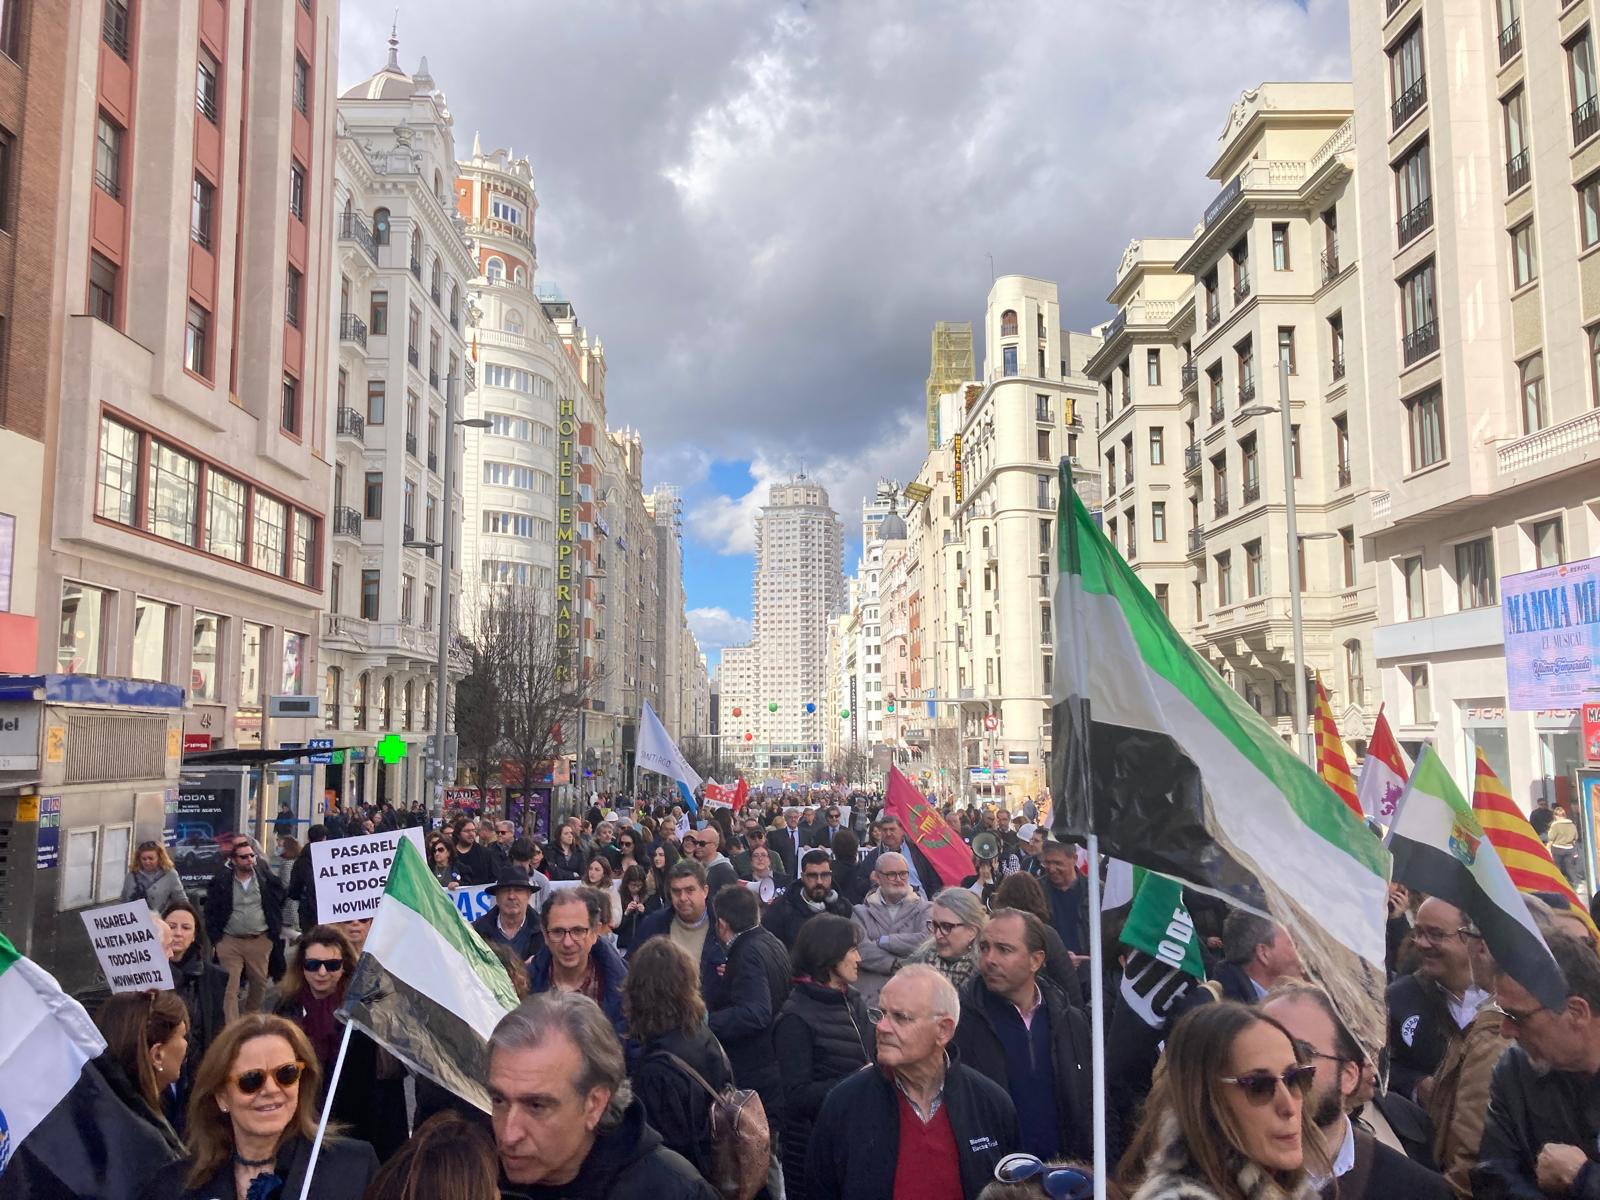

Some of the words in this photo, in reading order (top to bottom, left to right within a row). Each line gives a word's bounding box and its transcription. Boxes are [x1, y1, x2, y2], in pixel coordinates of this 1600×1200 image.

[560, 399, 574, 496] HOTEL
[1507, 586, 1572, 635] MAMMA
[1573, 580, 1600, 626] MI
[1542, 635, 1550, 650] EL
[1553, 631, 1585, 649] MUSICAL
[1554, 658, 1590, 676] Temporada
[319, 867, 338, 878] AL
[342, 861, 380, 875] RETA
[93, 912, 138, 930] PASARELA
[95, 937, 107, 949] AL
[104, 934, 127, 949] RETA
[124, 928, 155, 945] PARA
[107, 949, 151, 967] TODOS/AS
